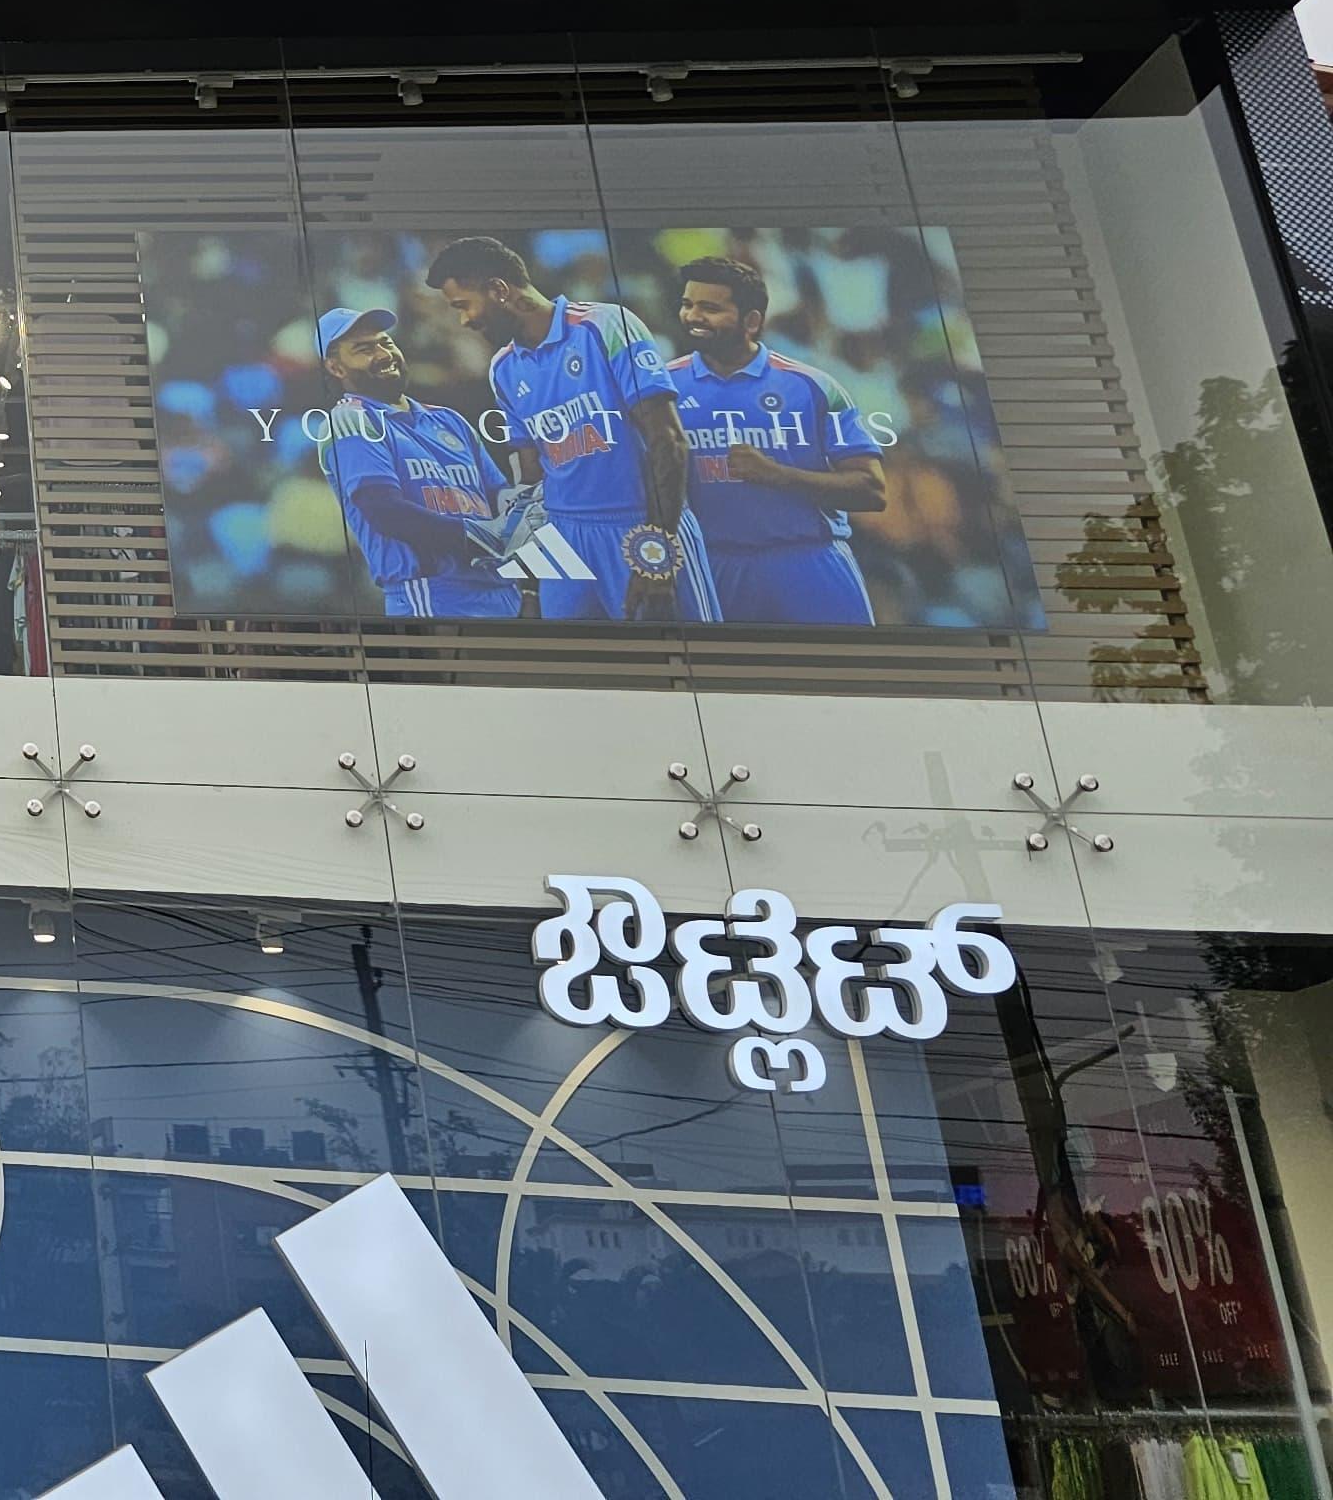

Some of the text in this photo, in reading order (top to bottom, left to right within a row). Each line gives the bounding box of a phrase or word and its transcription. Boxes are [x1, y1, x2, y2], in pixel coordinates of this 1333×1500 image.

[247, 407, 899, 447] YOU GOT THIS
